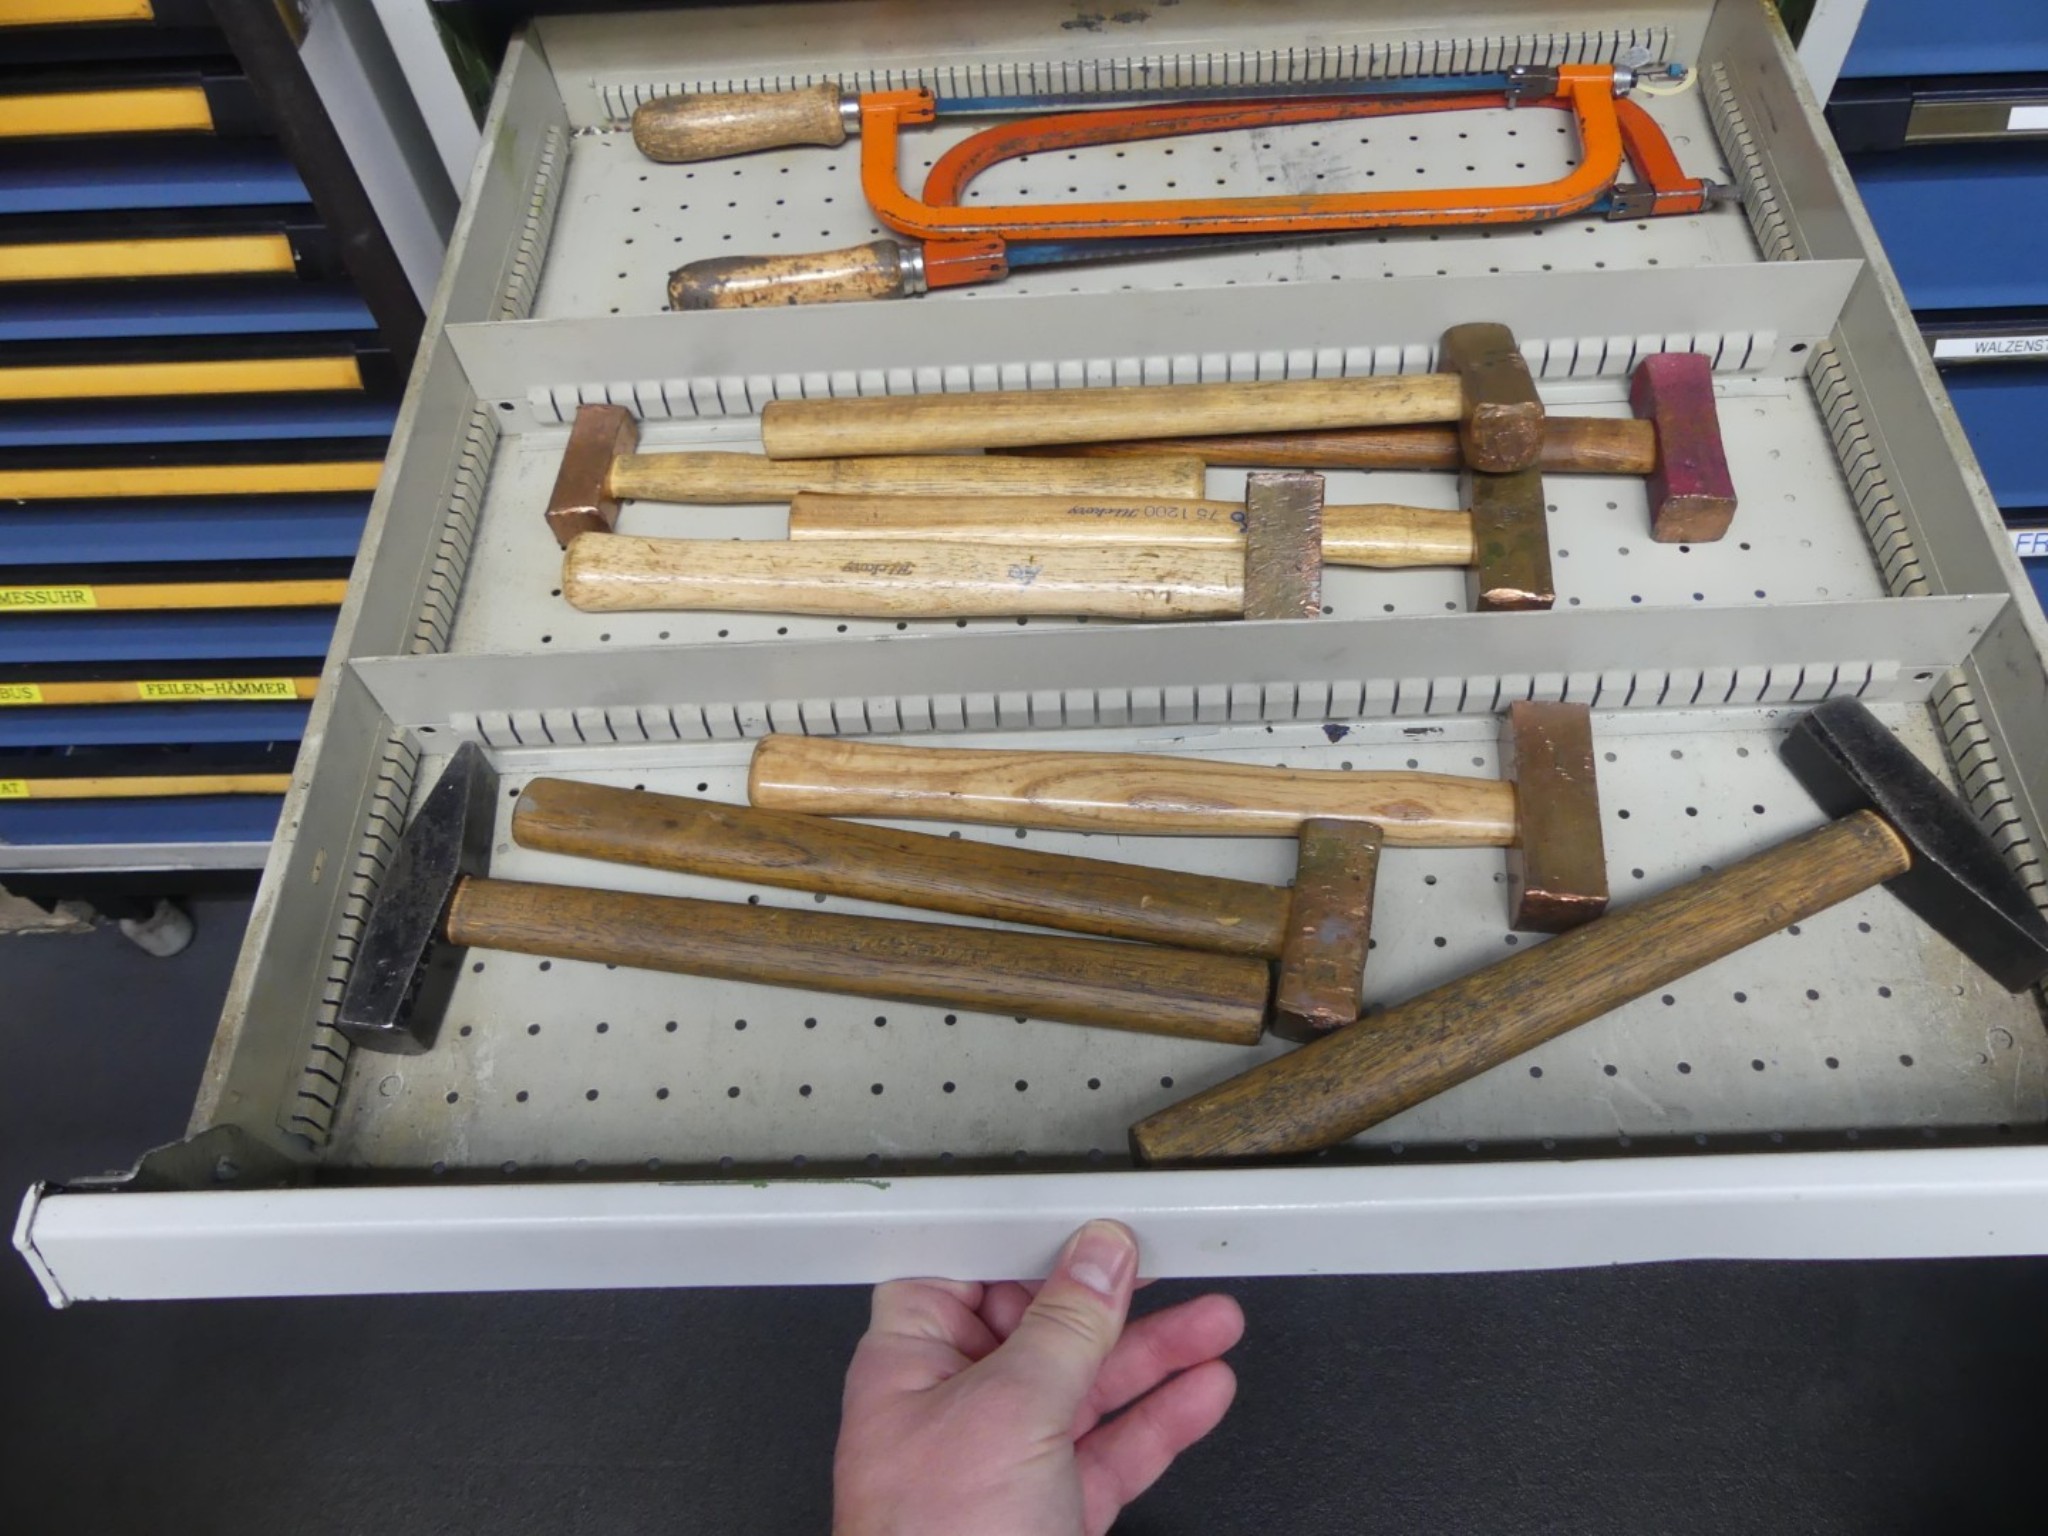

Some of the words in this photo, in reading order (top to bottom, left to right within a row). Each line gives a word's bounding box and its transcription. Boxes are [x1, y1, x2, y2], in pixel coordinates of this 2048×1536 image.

[1975, 340, 2048, 353] WALZENS
[1067, 505, 1139, 518] Hickory
[1144, 505, 1187, 519] 1200
[146, 682, 288, 695] FEILEN-HÄMMER
